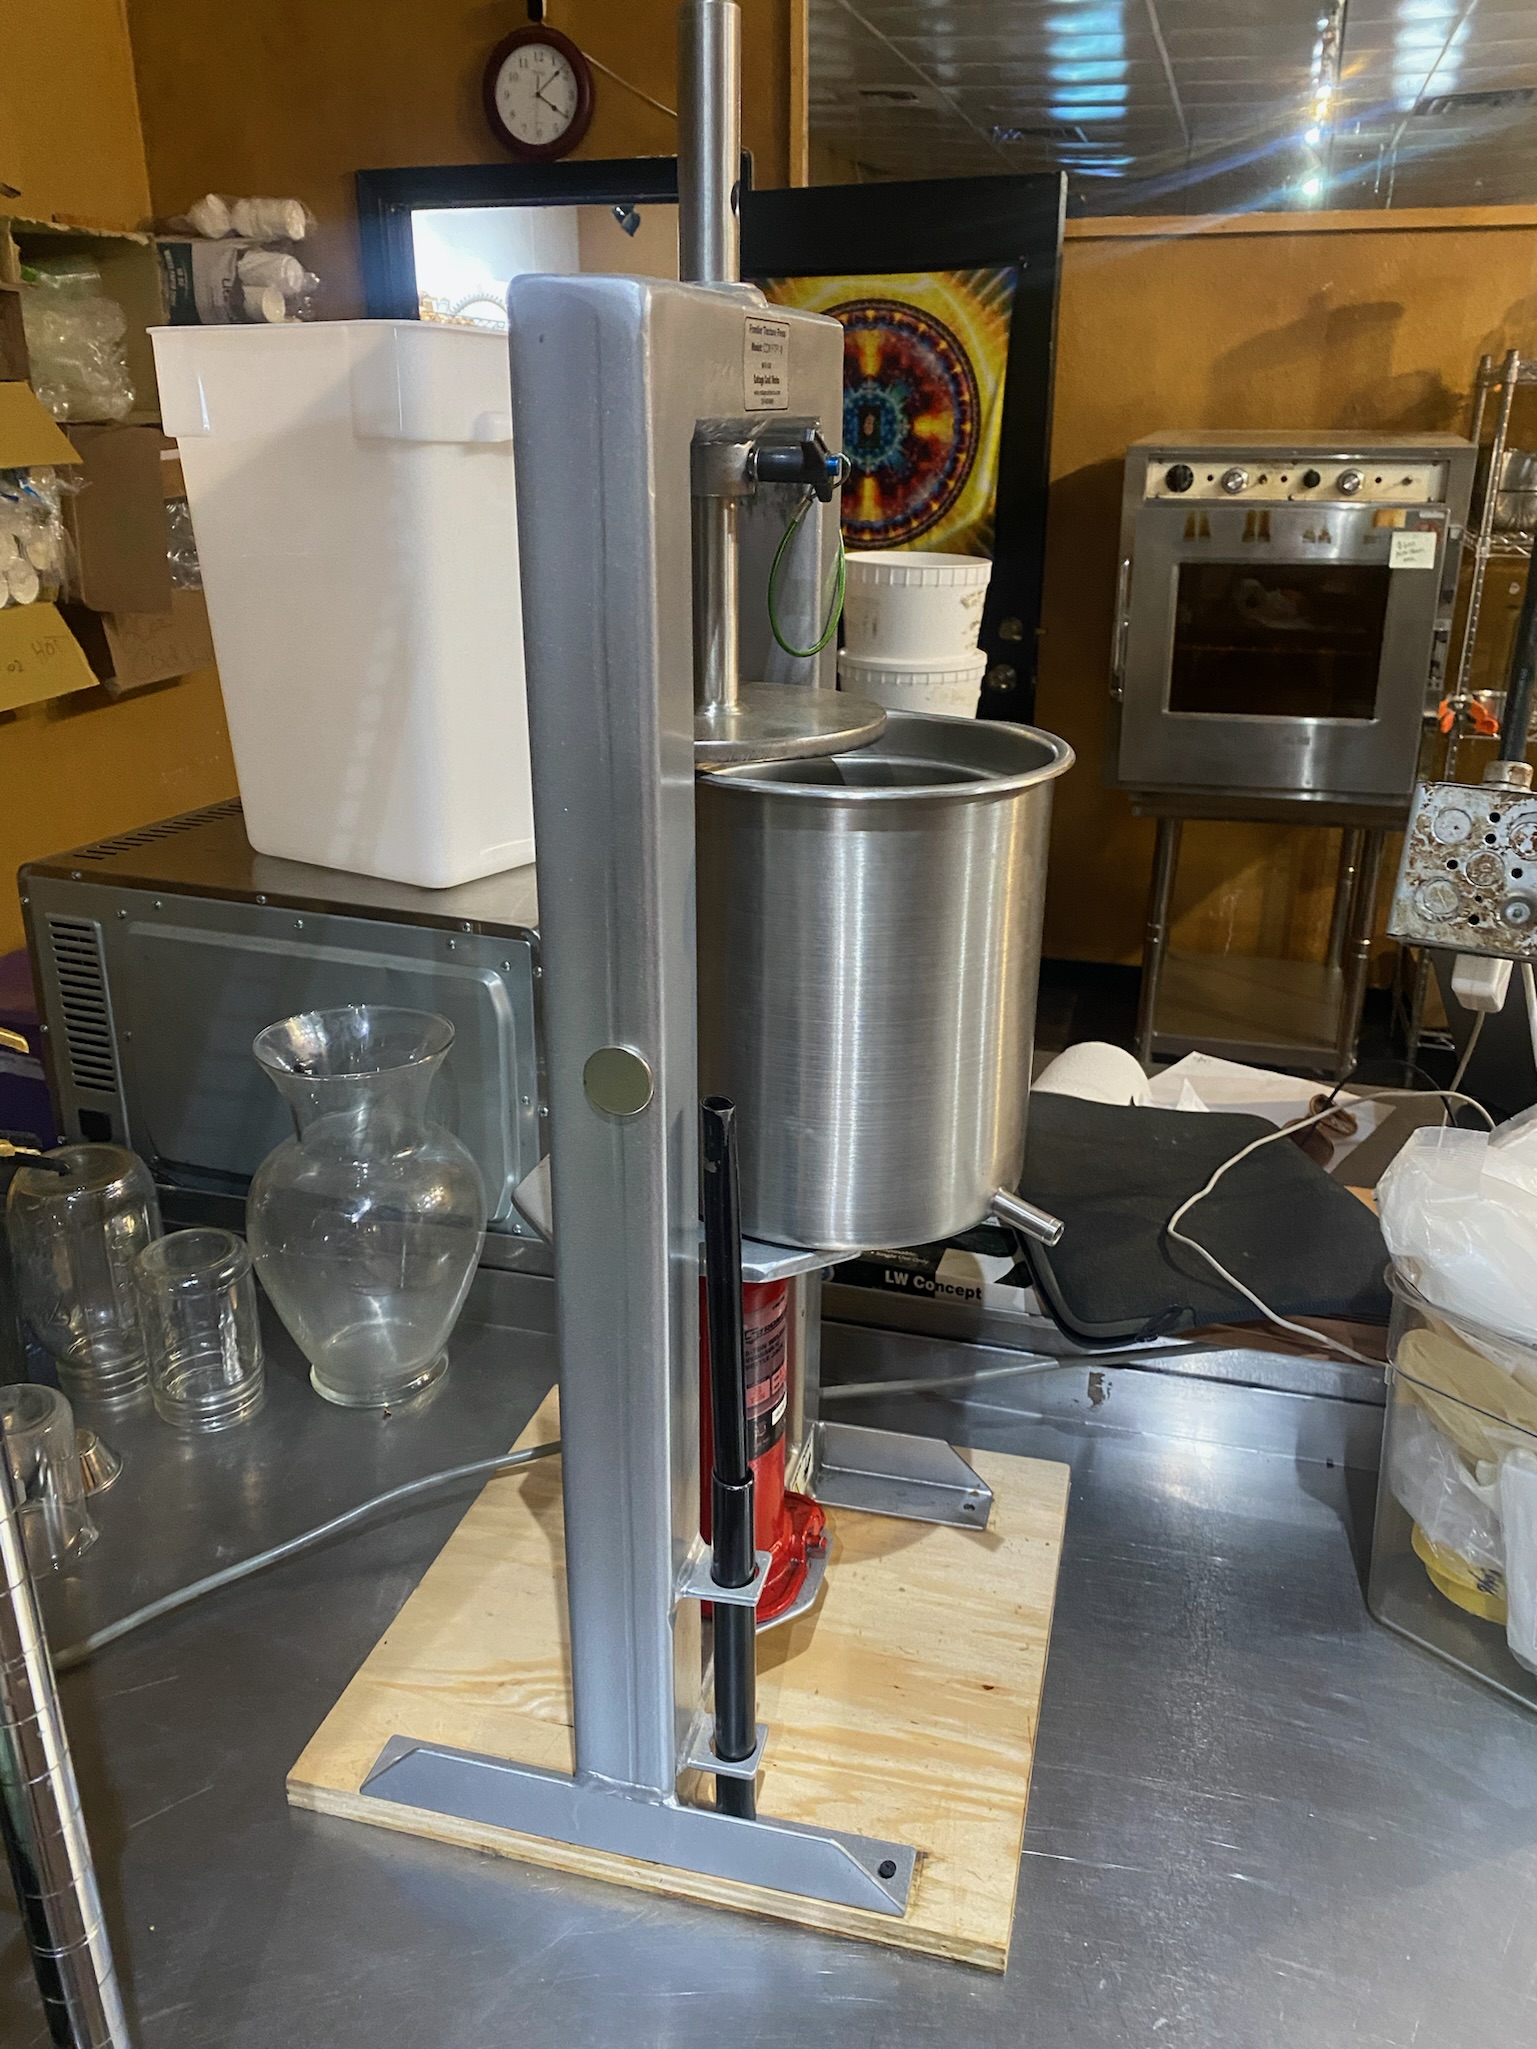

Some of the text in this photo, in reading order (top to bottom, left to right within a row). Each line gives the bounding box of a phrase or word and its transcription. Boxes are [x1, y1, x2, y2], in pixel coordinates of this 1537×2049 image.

[533, 51, 544, 62] 12
[519, 58, 528, 68] 11
[508, 72, 519, 82] 10
[884, 1270, 983, 1300] LW Concept
